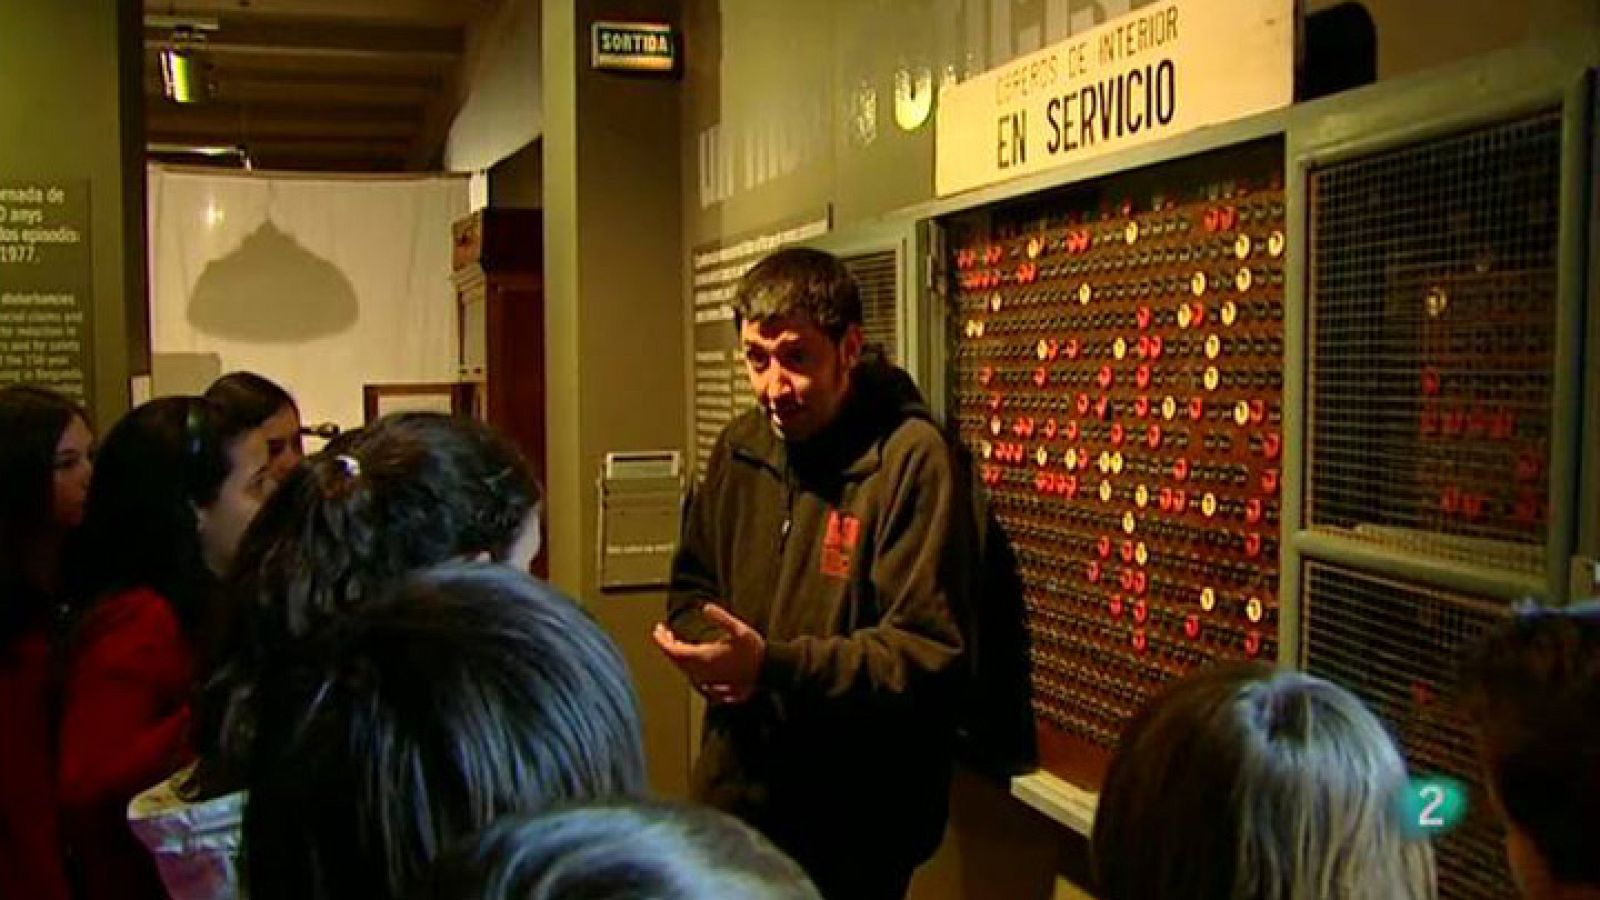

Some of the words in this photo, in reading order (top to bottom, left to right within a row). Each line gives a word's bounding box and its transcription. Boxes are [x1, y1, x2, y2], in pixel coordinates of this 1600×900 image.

[601, 31, 668, 53] SORTIDA
[1099, 5, 1179, 64] INTERIOR
[997, 108, 1027, 170] EN
[1046, 58, 1175, 155] SERVICIO
[46, 187, 65, 204] de
